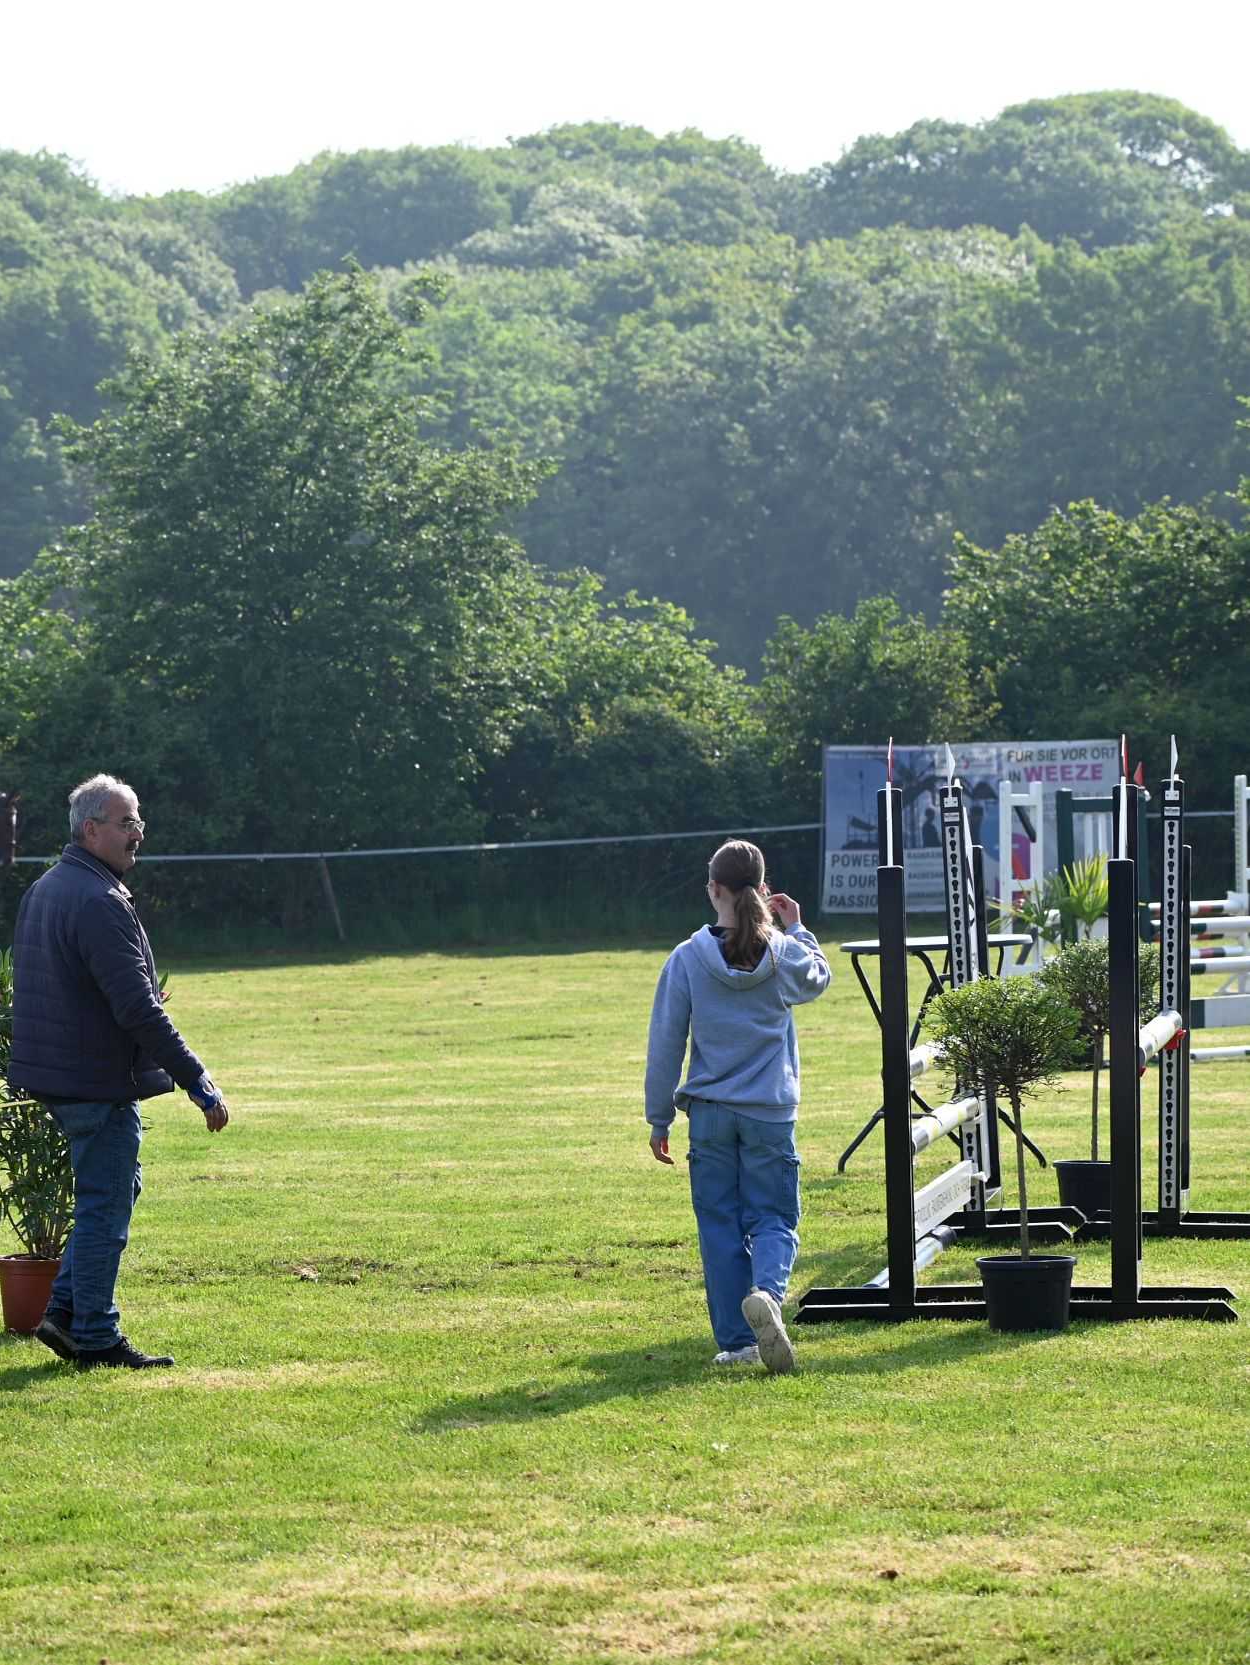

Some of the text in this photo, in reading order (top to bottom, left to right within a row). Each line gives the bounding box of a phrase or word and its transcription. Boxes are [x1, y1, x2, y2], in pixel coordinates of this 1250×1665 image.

[1037, 748, 1058, 761] SIE
[1061, 747, 1088, 761] VOR
[1091, 746, 1117, 760] ORT
[1009, 763, 1104, 783] IN WEEZE
[831, 853, 879, 868] POWER
[831, 874, 878, 889] IS OUR
[827, 895, 879, 908] PASSIO
